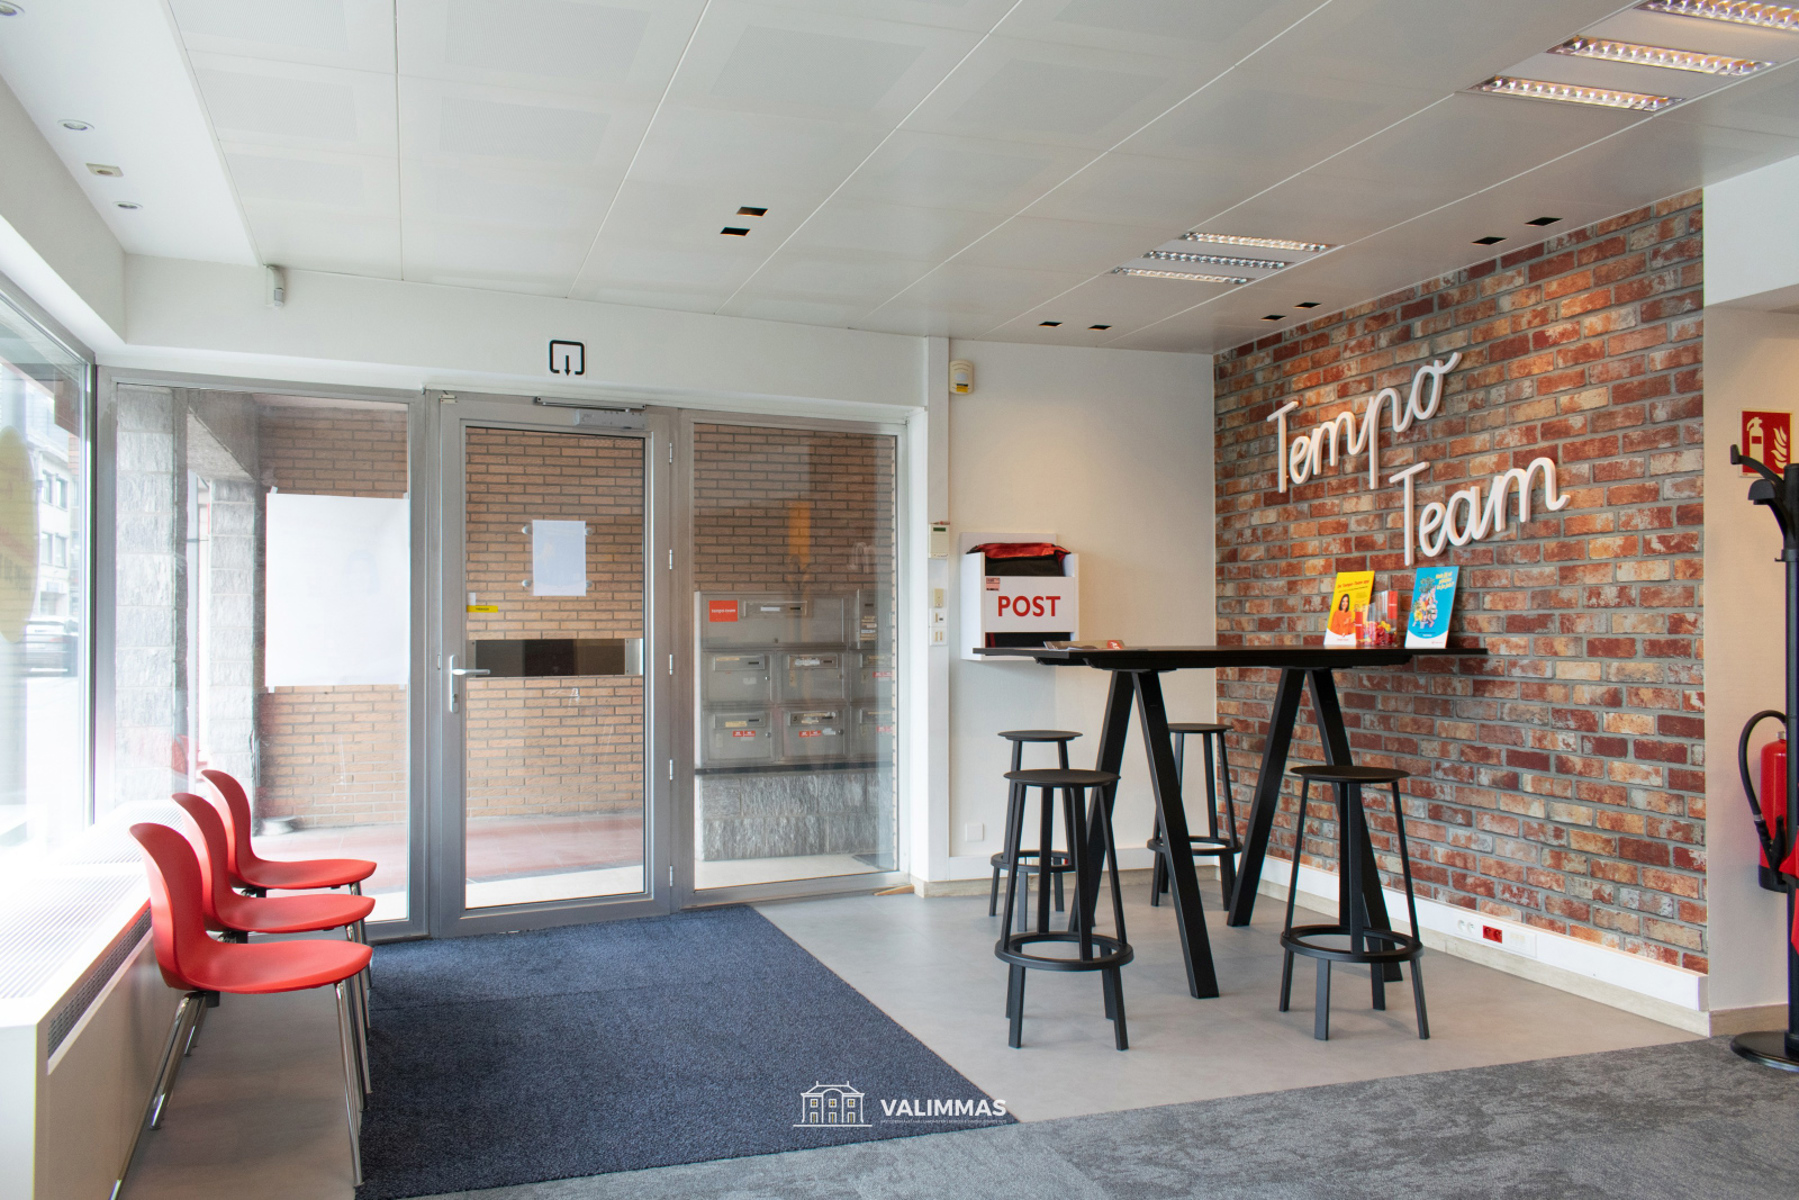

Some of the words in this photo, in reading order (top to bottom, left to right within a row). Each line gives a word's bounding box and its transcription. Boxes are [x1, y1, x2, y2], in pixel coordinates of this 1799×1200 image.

[1267, 352, 1462, 493] Tempo
[1389, 457, 1571, 566] Team
[998, 595, 1061, 617] POST
